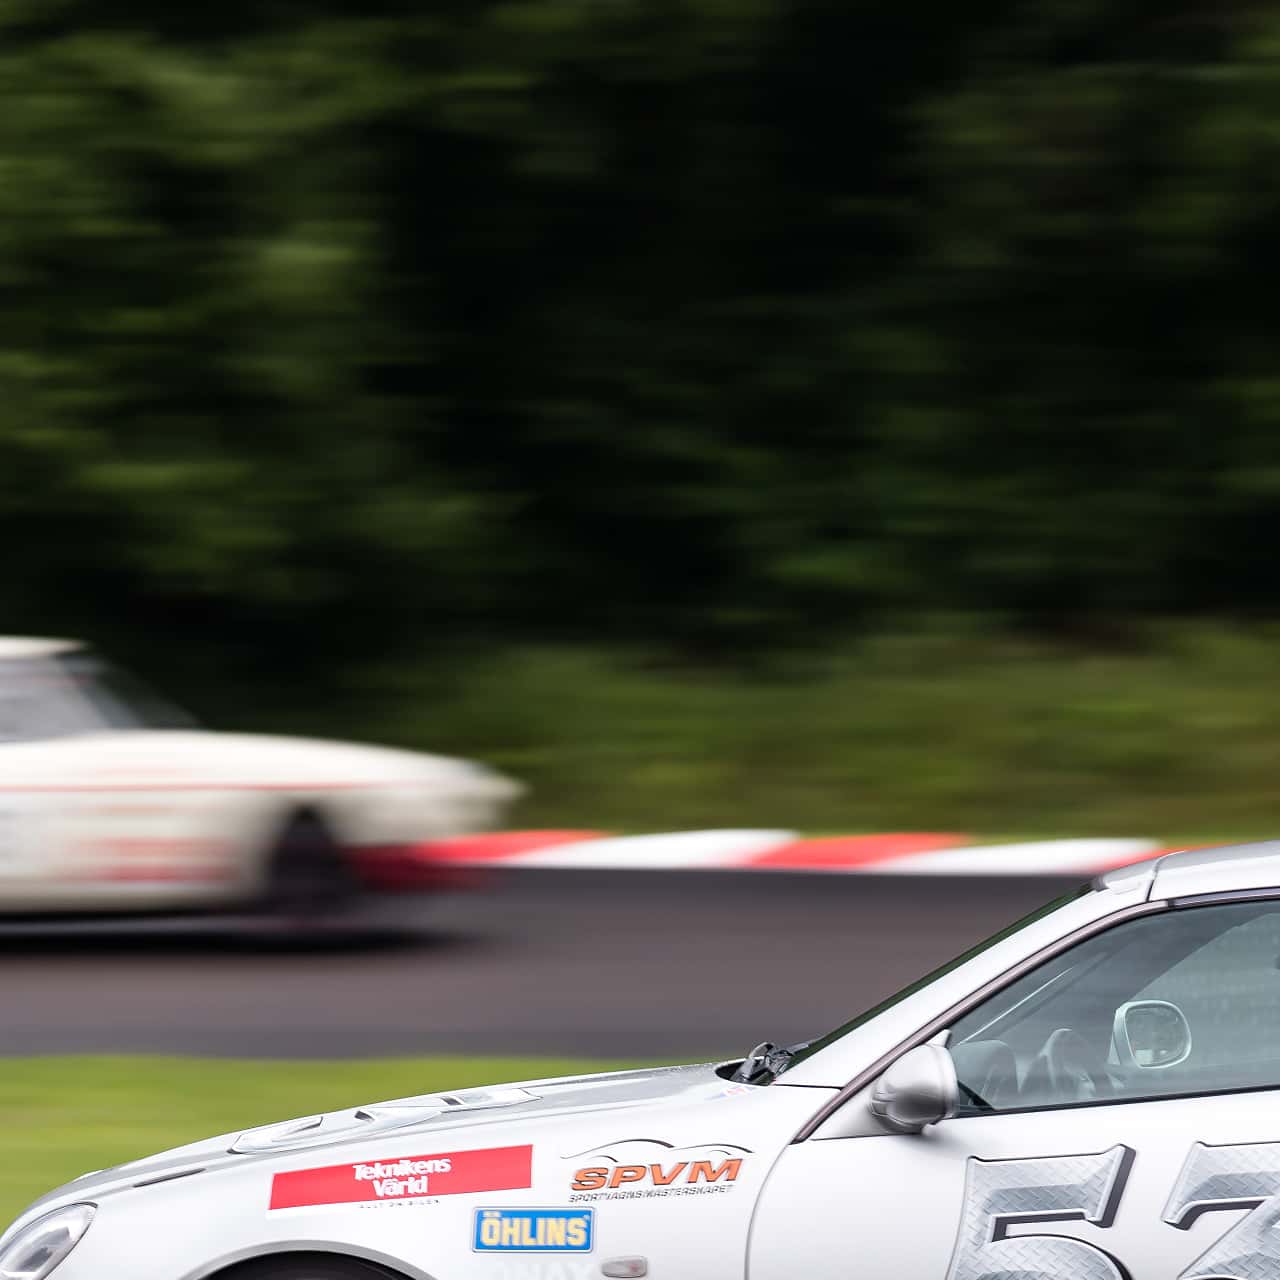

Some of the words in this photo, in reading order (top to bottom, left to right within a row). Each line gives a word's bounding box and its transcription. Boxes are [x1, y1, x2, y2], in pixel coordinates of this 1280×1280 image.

[352, 1159, 452, 1180] Teknikens
[571, 1158, 742, 1192] SPVM
[372, 1176, 428, 1198] Värld
[481, 1211, 587, 1246] ÖHLINS
